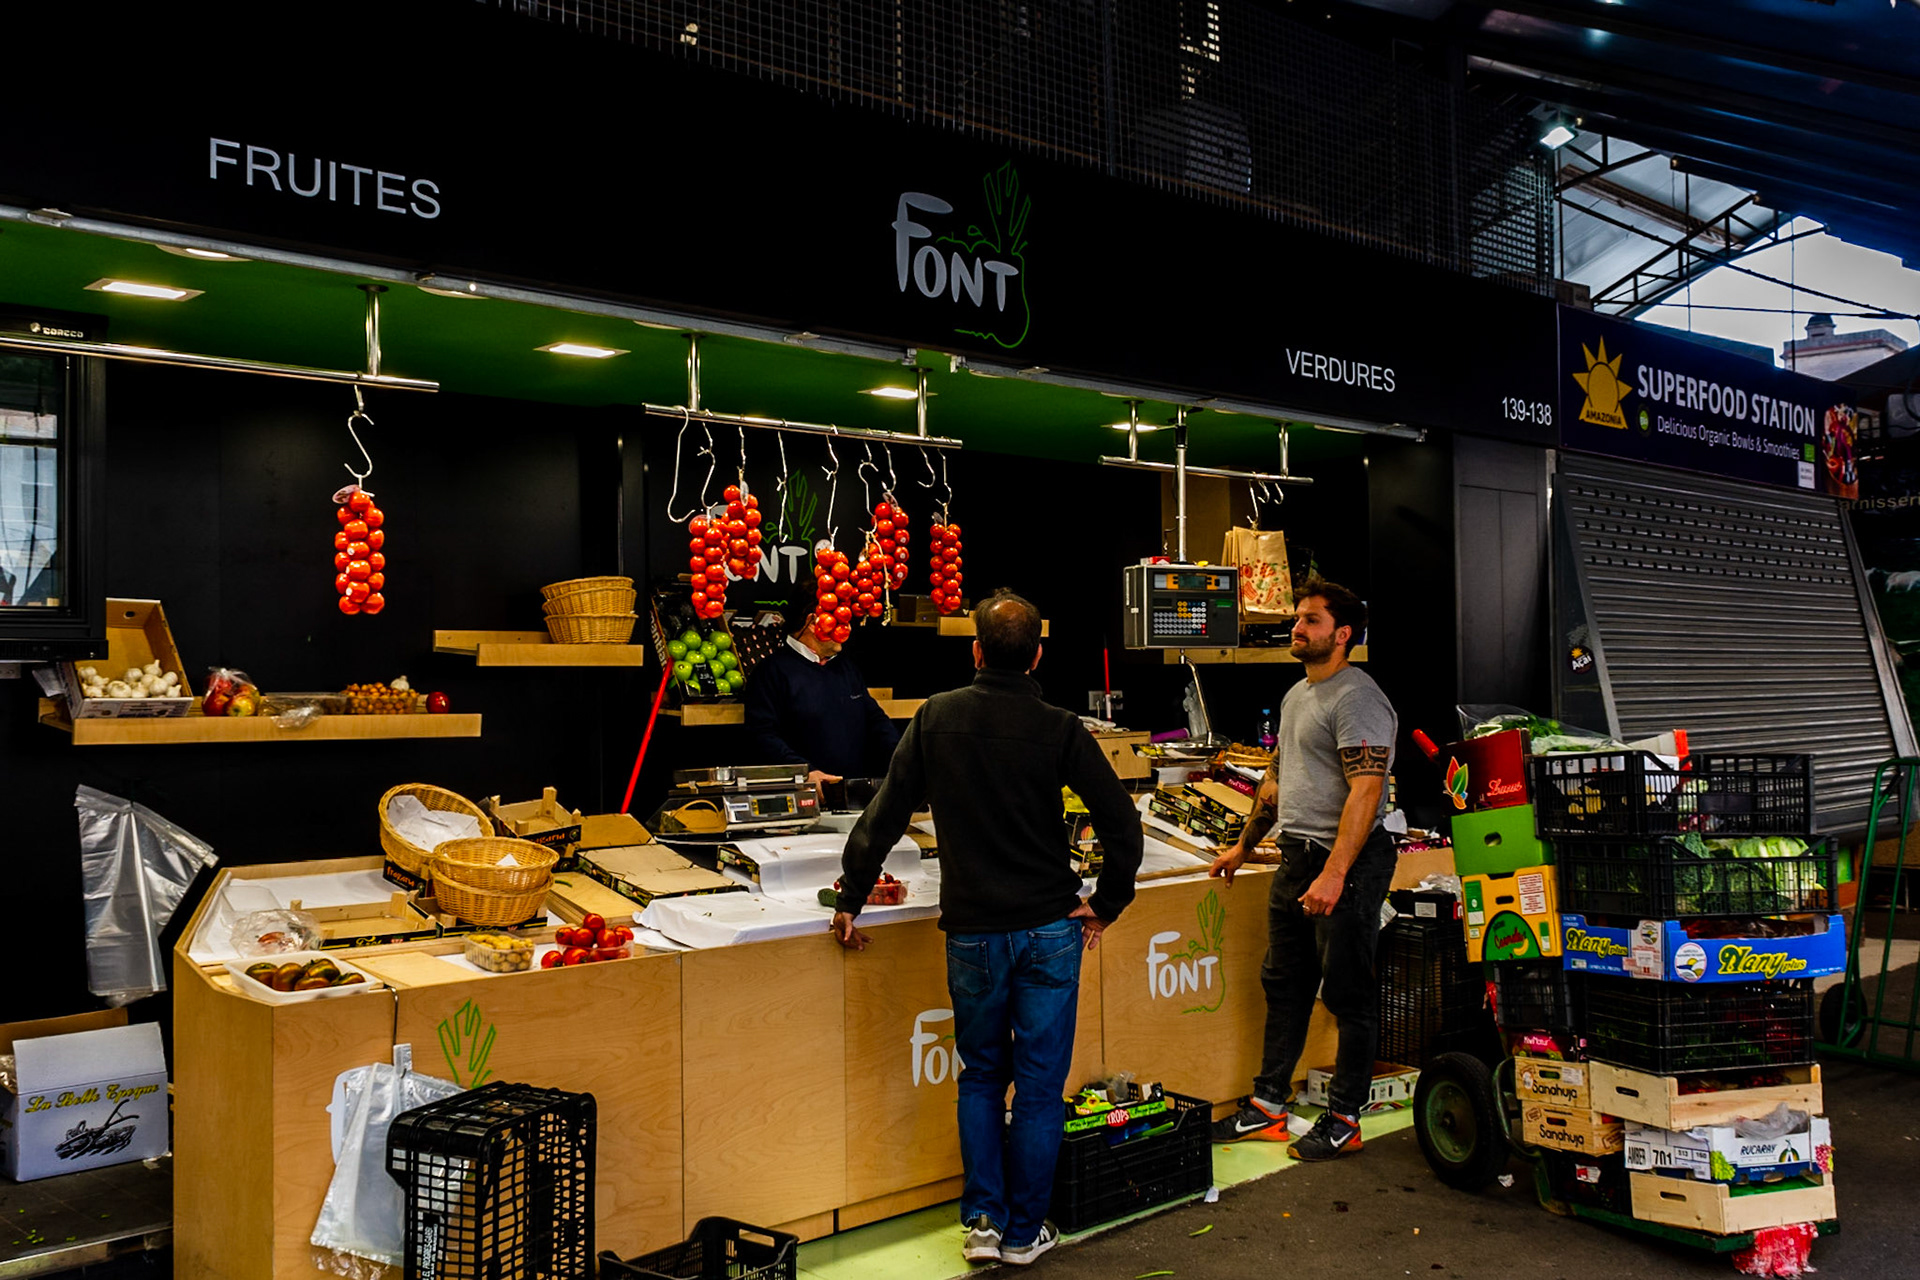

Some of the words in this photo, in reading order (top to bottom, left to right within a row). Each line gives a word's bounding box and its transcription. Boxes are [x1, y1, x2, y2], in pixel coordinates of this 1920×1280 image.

[209, 137, 441, 219] FRUITES
[891, 191, 1019, 312] FONT
[1286, 348, 1396, 393] VERDURES
[1502, 396, 1552, 426] 139-138
[1637, 364, 1748, 420] SUPERFOOD
[1751, 393, 1815, 437] STATION
[1585, 409, 1622, 425] AMAZONIA
[1657, 415, 1697, 440] Delicious
[1699, 424, 1730, 447] Organic
[1732, 431, 1755, 451] Bowls
[1756, 436, 1762, 452] &
[1763, 438, 1800, 460] Smoothies
[1566, 928, 1611, 958] Nany
[1146, 931, 1218, 1000] FONT
[1718, 944, 1788, 979] Nany
[1781, 958, 1807, 973] plus
[25, 1096, 51, 1113] La
[55, 1087, 100, 1109] Belle
[106, 1084, 159, 1104] Epoque
[1532, 1080, 1578, 1101] Sanahuja
[1107, 1109, 1130, 1124] TROPS
[1539, 1124, 1584, 1147] Sanahuja
[1740, 1144, 1778, 1156] RUCARAY
